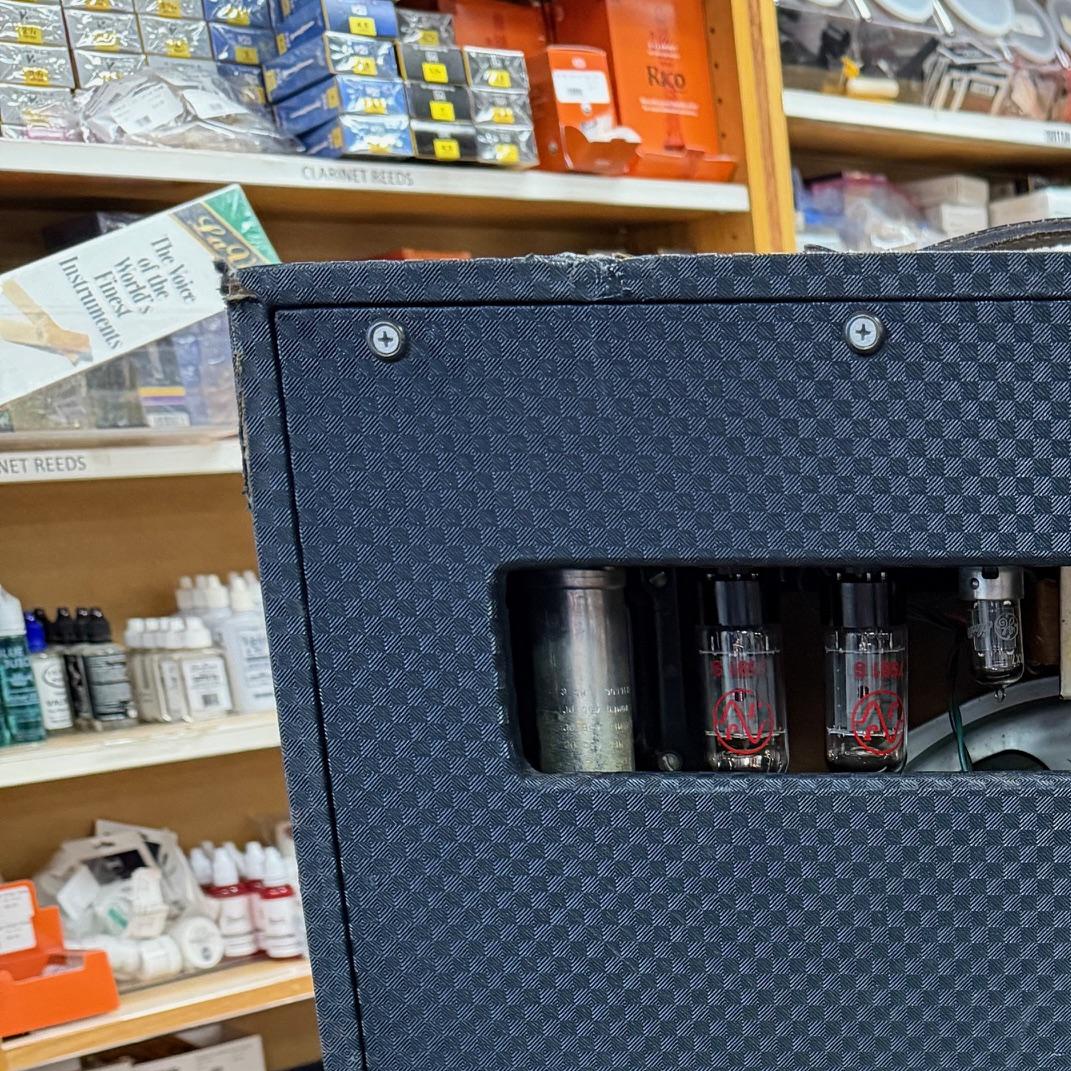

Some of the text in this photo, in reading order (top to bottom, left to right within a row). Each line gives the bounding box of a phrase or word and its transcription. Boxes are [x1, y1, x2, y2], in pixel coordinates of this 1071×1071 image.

[93, 270, 133, 318] Finest
[113, 256, 155, 315] World's
[136, 257, 170, 299] of the
[150, 235, 197, 302] The Voice
[58, 255, 121, 350] Instruments
[33, 455, 87, 473] REEDS
